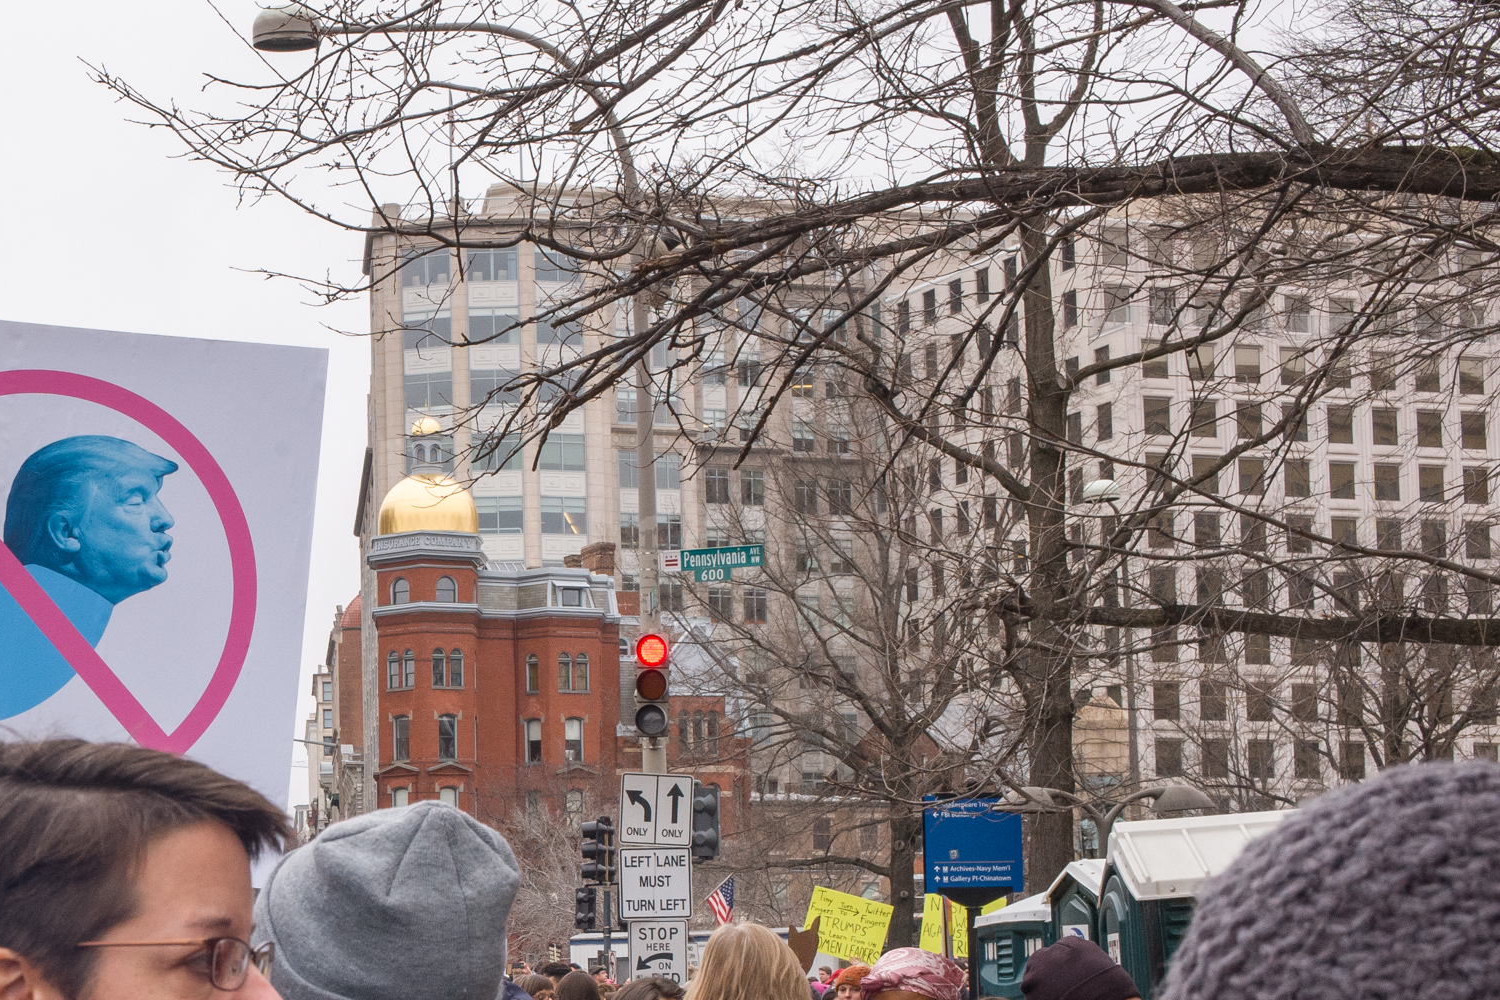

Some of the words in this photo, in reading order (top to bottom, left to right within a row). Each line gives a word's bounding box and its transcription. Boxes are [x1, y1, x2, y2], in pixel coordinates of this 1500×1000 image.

[375, 537, 420, 551] INSURANCE
[424, 536, 473, 549] COMPANY
[683, 548, 747, 568] Pennsylvania
[749, 547, 761, 555] AVE
[750, 556, 760, 564] NW
[701, 569, 724, 581] 600
[626, 827, 649, 837] ONLY
[661, 828, 684, 838] ONLY
[624, 856, 652, 868] LEFT
[656, 855, 687, 867] LANE
[639, 875, 671, 888] MUST
[950, 875, 971, 883] Gallery
[818, 889, 834, 907] Tiny
[626, 899, 655, 911] TURN
[660, 899, 687, 911] LEFT
[810, 901, 834, 916] Fingers
[865, 902, 891, 918] Twitter
[824, 915, 868, 937] TRUMPS
[860, 914, 887, 929] Fingers
[638, 927, 679, 941] STOP
[829, 930, 847, 940] Learn
[850, 935, 866, 945] From
[646, 943, 671, 951] HERE
[818, 936, 842, 954] OMEN
[843, 943, 880, 965] LEADERS
[658, 961, 672, 970] ON
